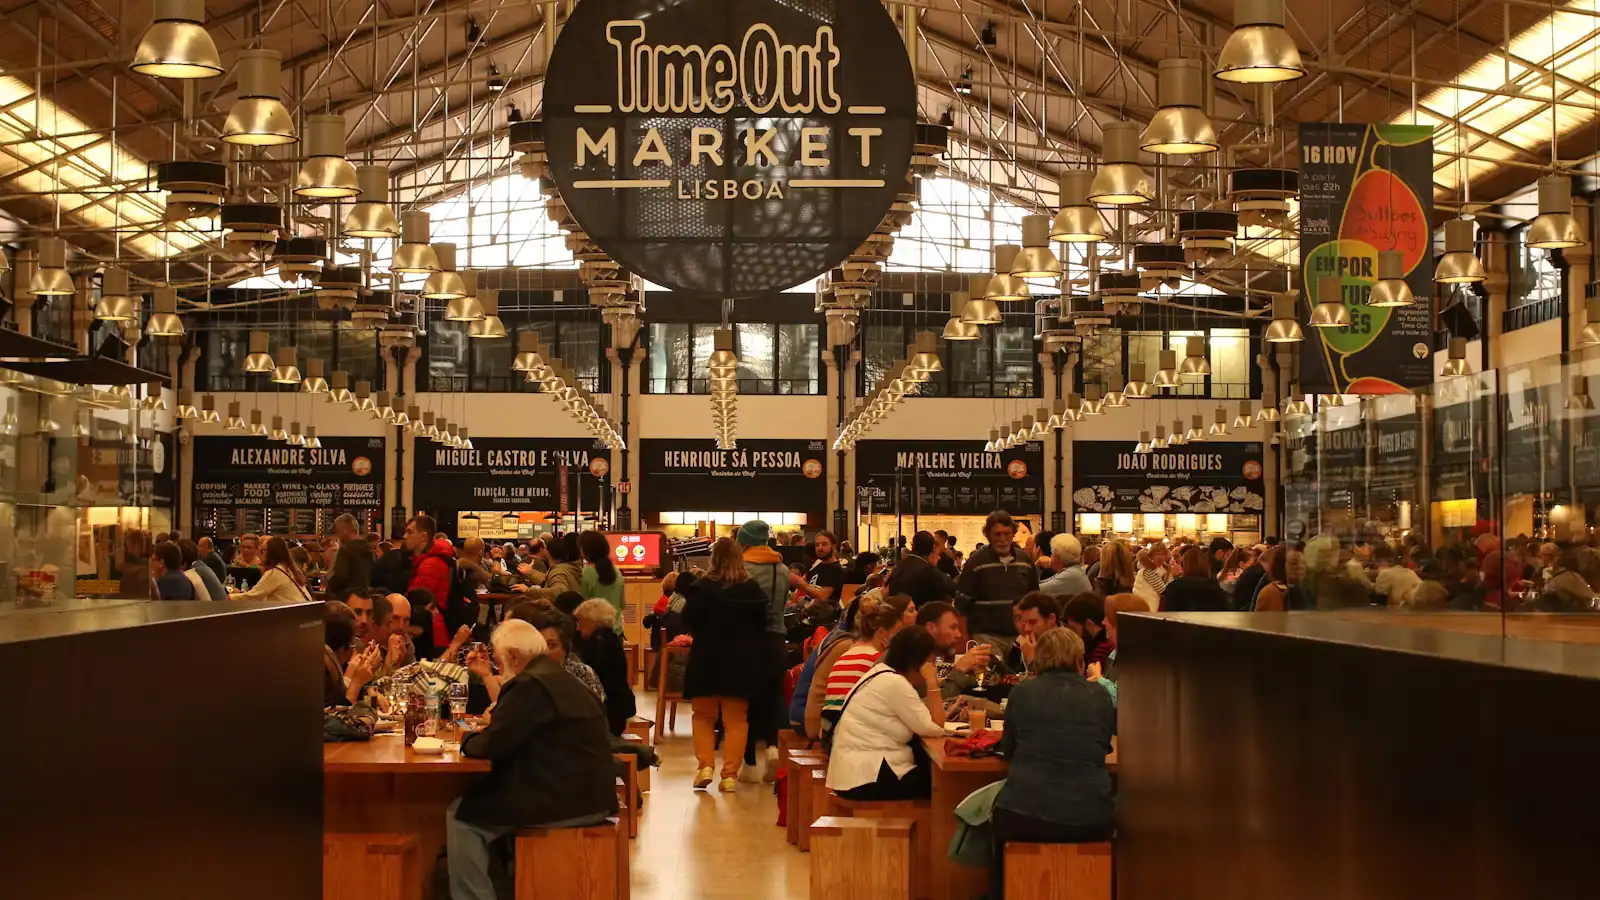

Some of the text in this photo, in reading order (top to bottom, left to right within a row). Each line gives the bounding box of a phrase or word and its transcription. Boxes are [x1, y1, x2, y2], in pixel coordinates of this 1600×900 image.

[606, 20, 841, 114] Time Out
[576, 127, 883, 167] MARKET
[1303, 145, 1321, 164] 16
[677, 180, 784, 200] LISBOA
[1338, 256, 1373, 278] POR
[231, 449, 346, 465] ALEXANDRE SILVA
[435, 450, 482, 467] MIGUEL
[487, 450, 535, 467] CASTRO
[541, 450, 547, 466] E
[664, 448, 801, 469] HENRIQUE SÁ PESSOA
[897, 452, 1001, 469] MARLENE VIEIRA
[1152, 453, 1222, 470] RODRIGUES
[244, 489, 270, 497] FOOD
[510, 487, 525, 497] SEM
